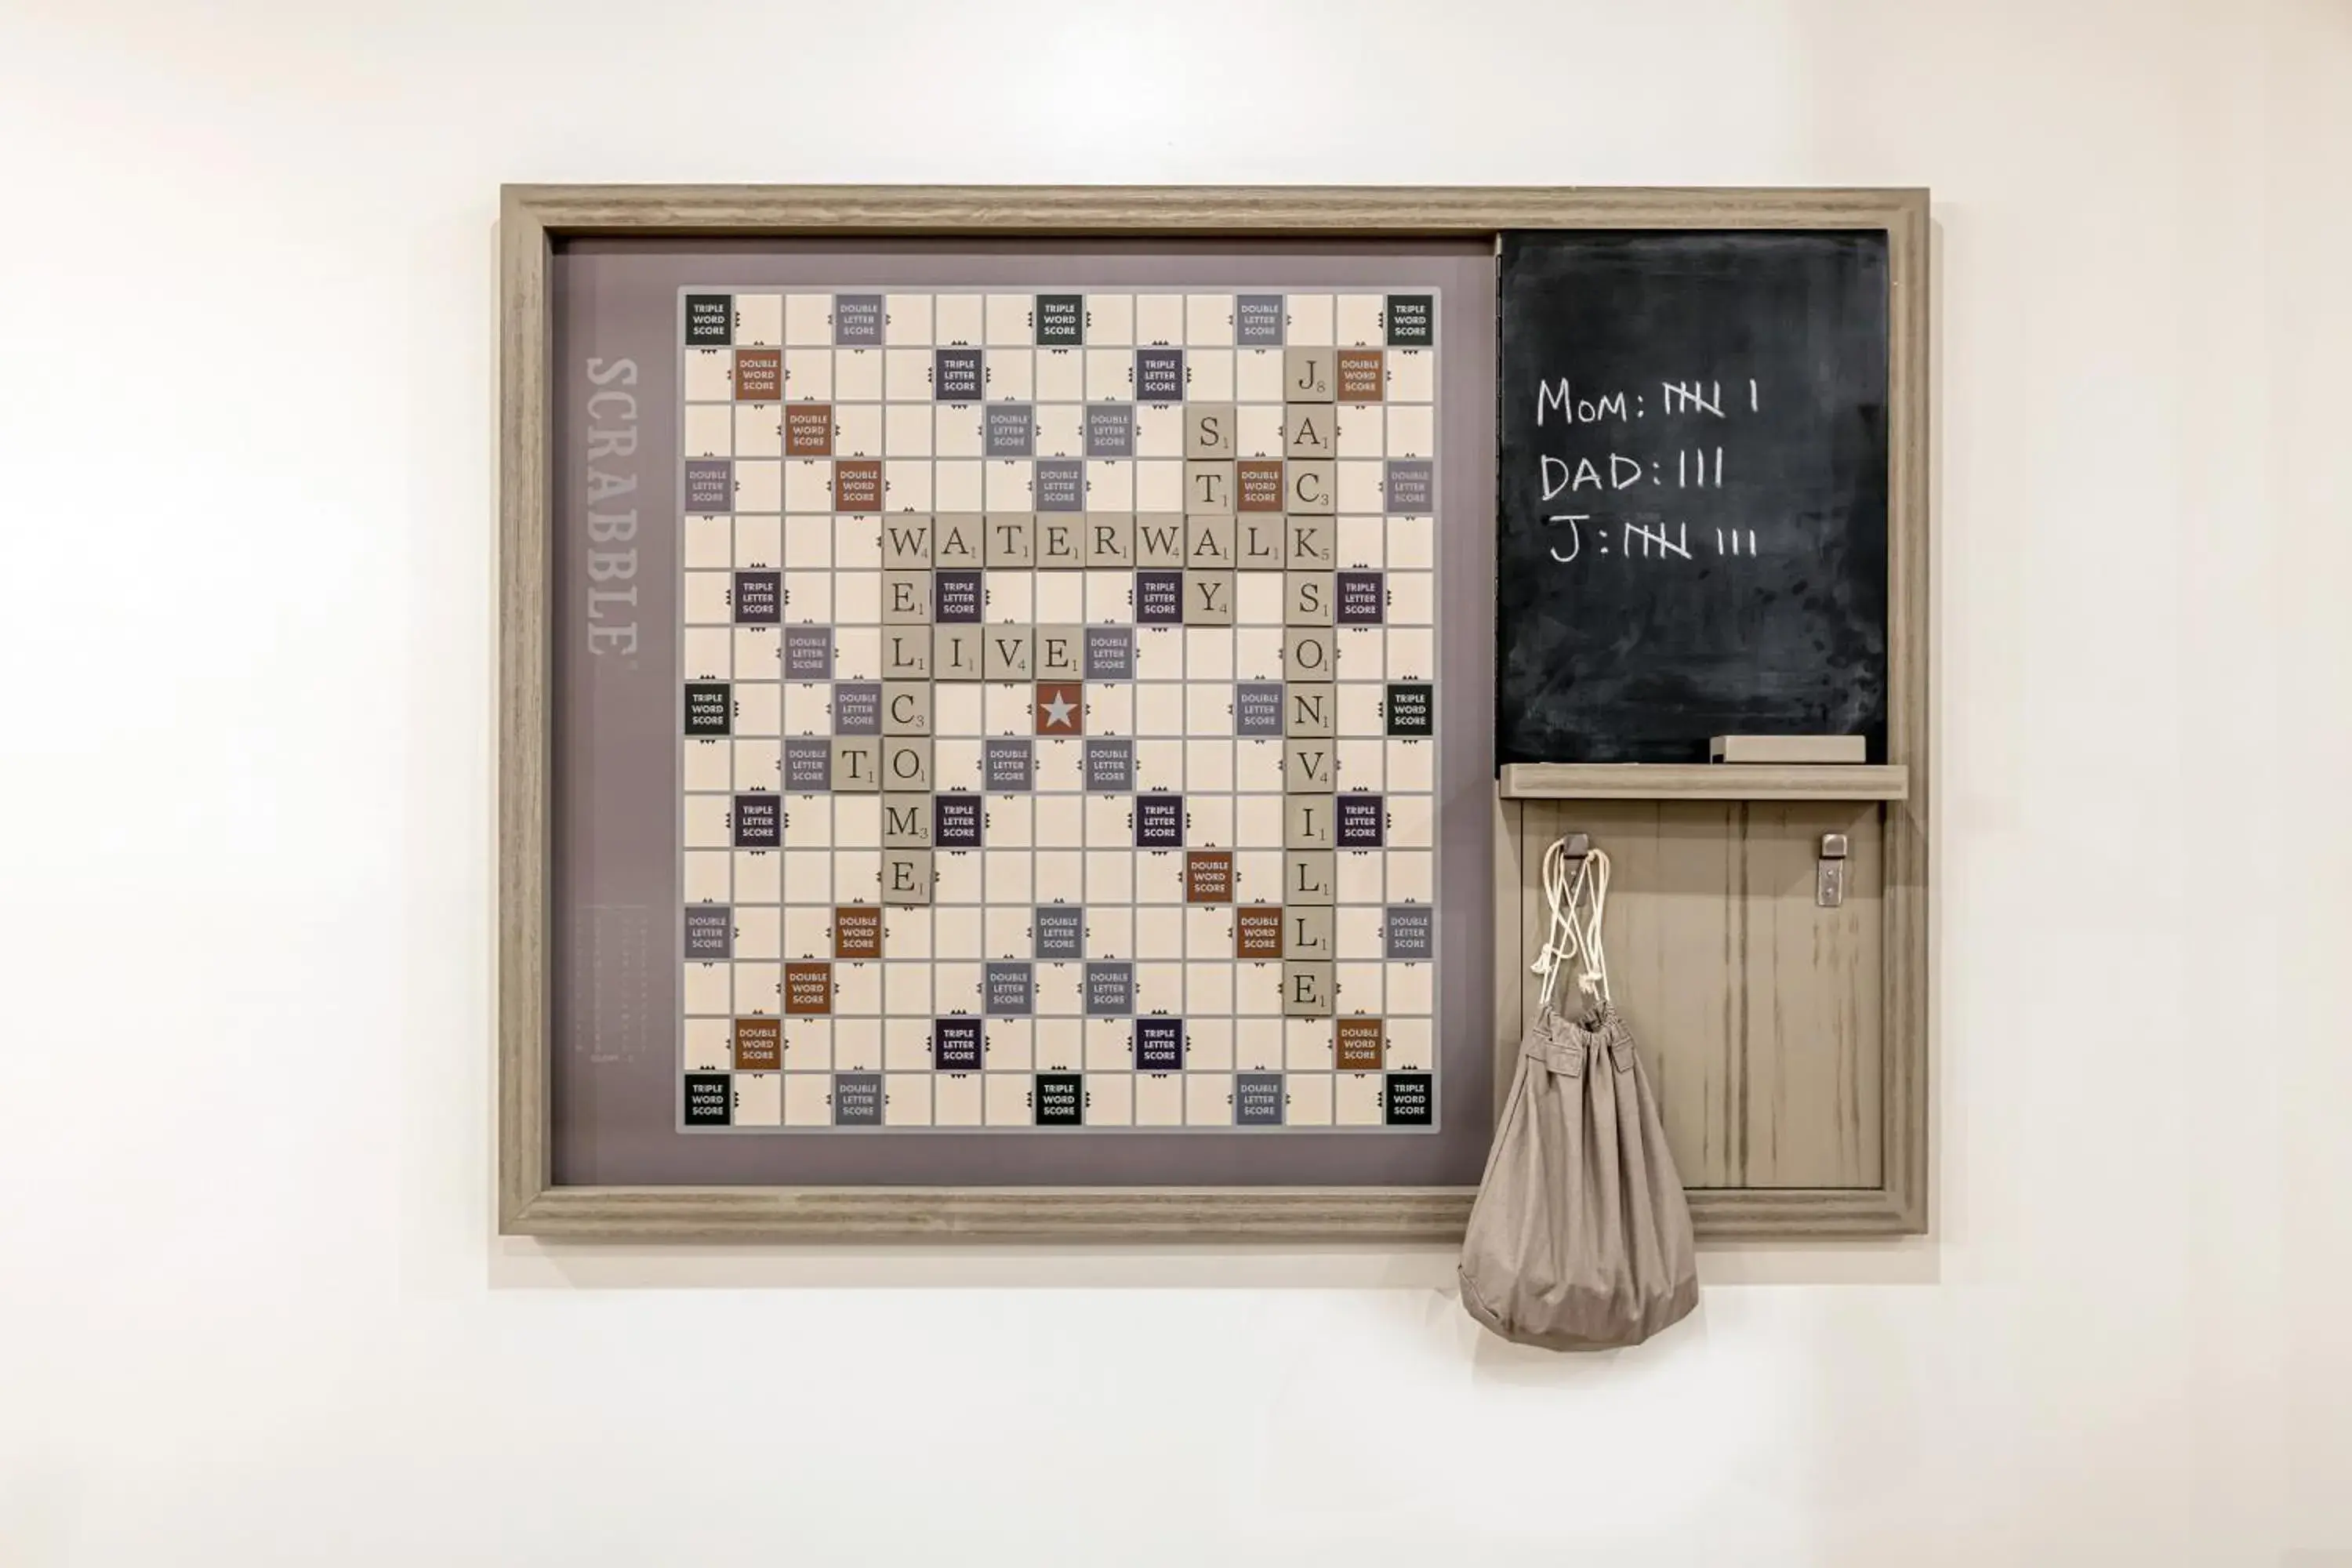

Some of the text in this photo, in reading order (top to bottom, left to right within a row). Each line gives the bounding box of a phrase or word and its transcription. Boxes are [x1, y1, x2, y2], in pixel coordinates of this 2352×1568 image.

[694, 304, 724, 313] TRIPLE
[840, 304, 878, 313] DOUBLE
[1045, 304, 1075, 313] TRIPLE
[1241, 304, 1279, 314] DOUBLE
[1395, 305, 1425, 314] TRIPLE
[692, 315, 725, 324] WORD
[844, 315, 874, 324] LETTER
[1044, 315, 1076, 324] WORD
[1394, 316, 1427, 325] WORD
[693, 326, 724, 336] SCORE
[843, 326, 874, 336] SCORE
[1044, 326, 1076, 335] SCORE
[1244, 326, 1275, 336] SCORE
[1395, 327, 1426, 336] SCORE
[739, 359, 778, 368] DOUBLE
[944, 360, 975, 369] TRIPLE
[1145, 360, 1175, 369] TRIPLE
[1341, 360, 1379, 369] DOUBLE
[742, 370, 775, 379] WORD
[944, 371, 975, 380] LETTER
[1145, 371, 1175, 380] LETTER
[1344, 371, 1376, 380] WORD
[743, 382, 774, 390] SCORE
[944, 382, 975, 391] SCORE
[1145, 382, 1175, 391] SCORE
[1345, 382, 1376, 391] SCORE
[789, 415, 827, 424] DOUBLE
[793, 426, 825, 435] WORD
[793, 437, 824, 446] SCORE
[840, 470, 877, 479] DOUBLE
[1040, 470, 1078, 480] DOUBLE
[1241, 471, 1279, 480] DOUBLE
[843, 481, 875, 490] WORD
[1244, 482, 1276, 491] WORD
[843, 492, 874, 501] SCORE
[1044, 492, 1075, 502] SCORE
[1244, 493, 1276, 502] SCORE
[586, 358, 638, 656] SCRABBLE
[742, 583, 774, 591] TRIPLE
[943, 583, 975, 591] TRIPLE
[1145, 583, 1175, 592] TRIPLE
[1345, 583, 1375, 592] TRIPLE
[742, 593, 774, 603] LETTER
[943, 593, 975, 602] LETTER
[1144, 593, 1175, 603] LETTER
[1345, 593, 1376, 603] LETTER
[742, 604, 774, 614] SCORE
[943, 604, 975, 614] SCORE
[1145, 604, 1175, 614] SCORE
[1345, 604, 1376, 614] SCORE
[1091, 637, 1128, 647] DOUBLE
[1094, 648, 1124, 658] LETTER
[1094, 660, 1125, 669] SCORE
[692, 694, 723, 702] TRIPLE
[839, 694, 877, 703] DOUBLE
[1241, 694, 1279, 703] DOUBLE
[1395, 694, 1425, 703] TRIPLE
[691, 705, 724, 713] WORD
[843, 705, 873, 713] LETTER
[1244, 705, 1275, 714] LETTER
[1394, 705, 1426, 714] WORD
[692, 716, 724, 725] SCORE
[842, 716, 873, 725] SCORE
[1244, 716, 1276, 725] SCORE
[1395, 716, 1426, 725] SCORE
[789, 750, 826, 759] DOUBLE
[990, 750, 1028, 758] DOUBLE
[1091, 750, 1128, 759] DOUBLE
[792, 760, 823, 770] LETTER
[1094, 760, 1124, 770] LETTER
[793, 771, 823, 781] SCORE
[993, 772, 1024, 781] SCORE
[1094, 772, 1124, 781] SCORE
[742, 805, 773, 815] TRIPLE
[944, 805, 974, 815] TRIPLE
[1144, 806, 1175, 815] TRIPLE
[1345, 806, 1375, 815] TRIPLE
[742, 817, 774, 826] LETTER
[943, 817, 975, 826] LETTER
[1144, 817, 1175, 826] LETTER
[1345, 817, 1376, 826] LETTER
[742, 828, 774, 837] SCORE
[943, 828, 975, 837] SCORE
[1144, 828, 1175, 837] SCORE
[1345, 828, 1376, 837] SCORE
[1191, 862, 1229, 870] DOUBLE
[1194, 873, 1226, 881] WORD
[1194, 884, 1225, 892] SCORE
[688, 916, 726, 926] DOUBLE
[839, 916, 877, 926] DOUBLE
[1040, 917, 1078, 926] DOUBLE
[1240, 916, 1279, 926] DOUBLE
[1390, 916, 1428, 926] DOUBLE
[691, 928, 723, 937] LETTER
[842, 928, 874, 937] WORD
[1044, 928, 1074, 937] LETTER
[1243, 928, 1276, 937] WORD
[1394, 927, 1425, 937] LETTER
[692, 939, 723, 949] SCORE
[842, 939, 874, 948] SCORE
[1044, 939, 1075, 948] SCORE
[1244, 939, 1276, 948] SCORE
[1395, 939, 1425, 948] SCORE
[789, 973, 827, 982] DOUBLE
[989, 973, 1028, 982] DOUBLE
[1090, 973, 1128, 982] DOUBLE
[792, 984, 824, 993] WORD
[993, 984, 1024, 993] LETTER
[1093, 984, 1124, 993] LETTER
[793, 995, 824, 1004] SCORE
[993, 995, 1024, 1004] SCORE
[1094, 995, 1124, 1004] SCORE
[739, 1028, 777, 1037] DOUBLE
[943, 1029, 974, 1038] TRIPLE
[1144, 1029, 1174, 1038] TRIPLE
[1341, 1028, 1378, 1037] DOUBLE
[742, 1040, 774, 1048] WORD
[943, 1040, 975, 1049] LETTER
[1144, 1040, 1175, 1049] LETTER
[1344, 1039, 1376, 1048] WORD
[742, 1051, 774, 1059] SCORE
[943, 1051, 975, 1060] SCORE
[1144, 1051, 1175, 1060] SCORE
[1344, 1051, 1375, 1059] SCORE
[692, 1084, 723, 1094] TRIPLE
[840, 1084, 877, 1094] DOUBLE
[1044, 1084, 1074, 1094] TRIPLE
[1240, 1084, 1278, 1093] DOUBLE
[691, 1095, 724, 1105] WORD
[843, 1095, 873, 1105] LETTER
[1043, 1095, 1075, 1105] WORD
[1243, 1095, 1274, 1105] LETTER
[1393, 1095, 1426, 1104] WORD
[692, 1106, 724, 1116] SCORE
[842, 1106, 874, 1116] SCORE
[1044, 1106, 1075, 1116] SCORE
[1244, 1106, 1274, 1116] SCORE
[1394, 1106, 1425, 1115] SCORE
